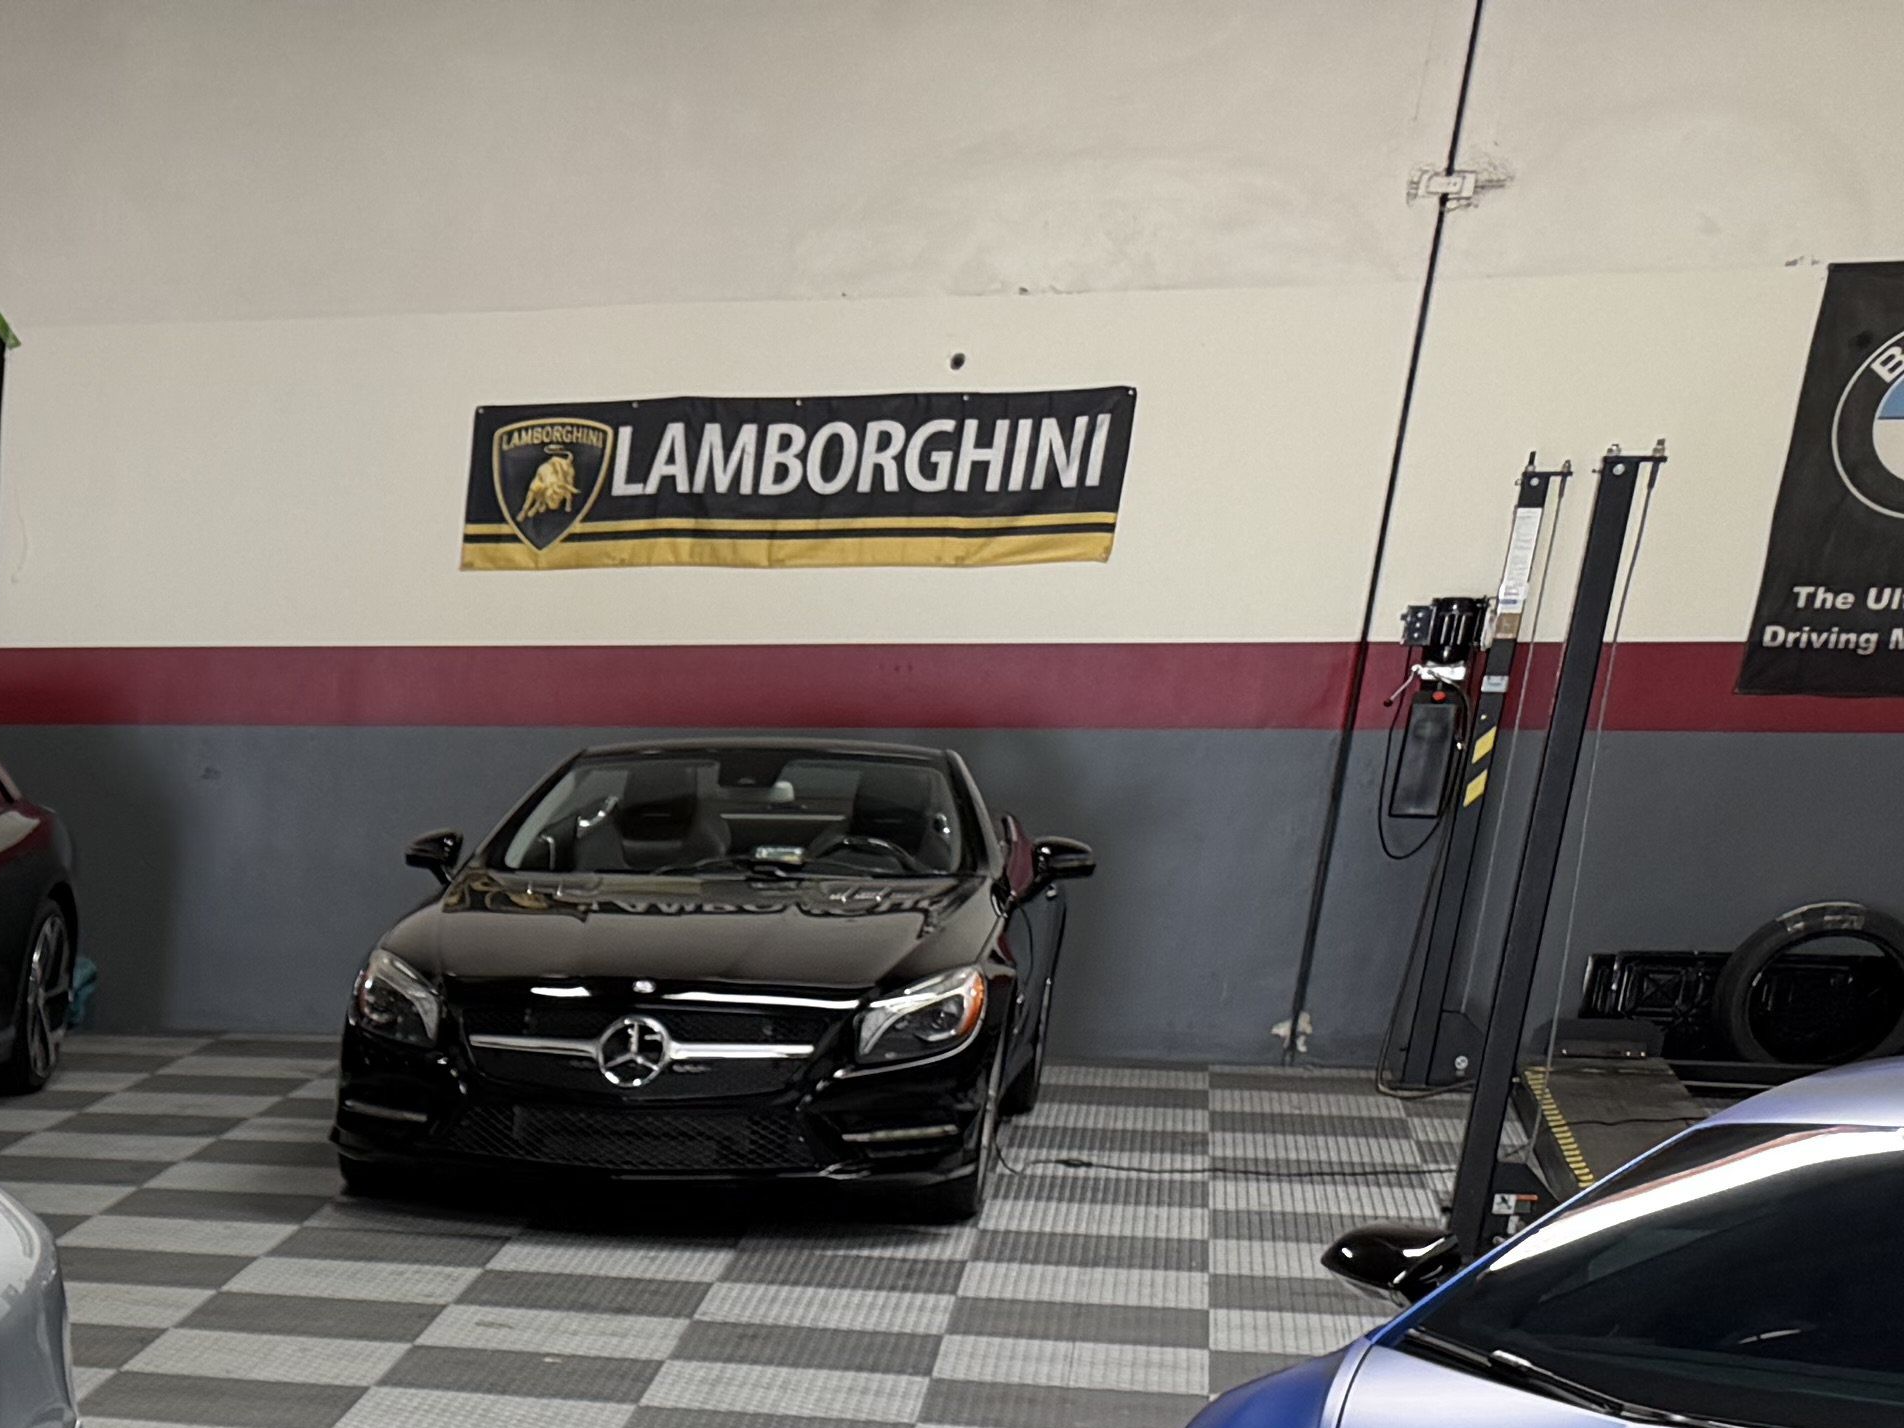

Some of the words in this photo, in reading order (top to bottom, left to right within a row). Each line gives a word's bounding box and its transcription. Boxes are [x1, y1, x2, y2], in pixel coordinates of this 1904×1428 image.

[502, 425, 604, 451] LAMBORGHINI
[610, 413, 1113, 497] LAMBORGHINI
[1792, 586, 1856, 610] The
[1866, 586, 1904, 611] Ul
[1762, 625, 1879, 655] Driving
